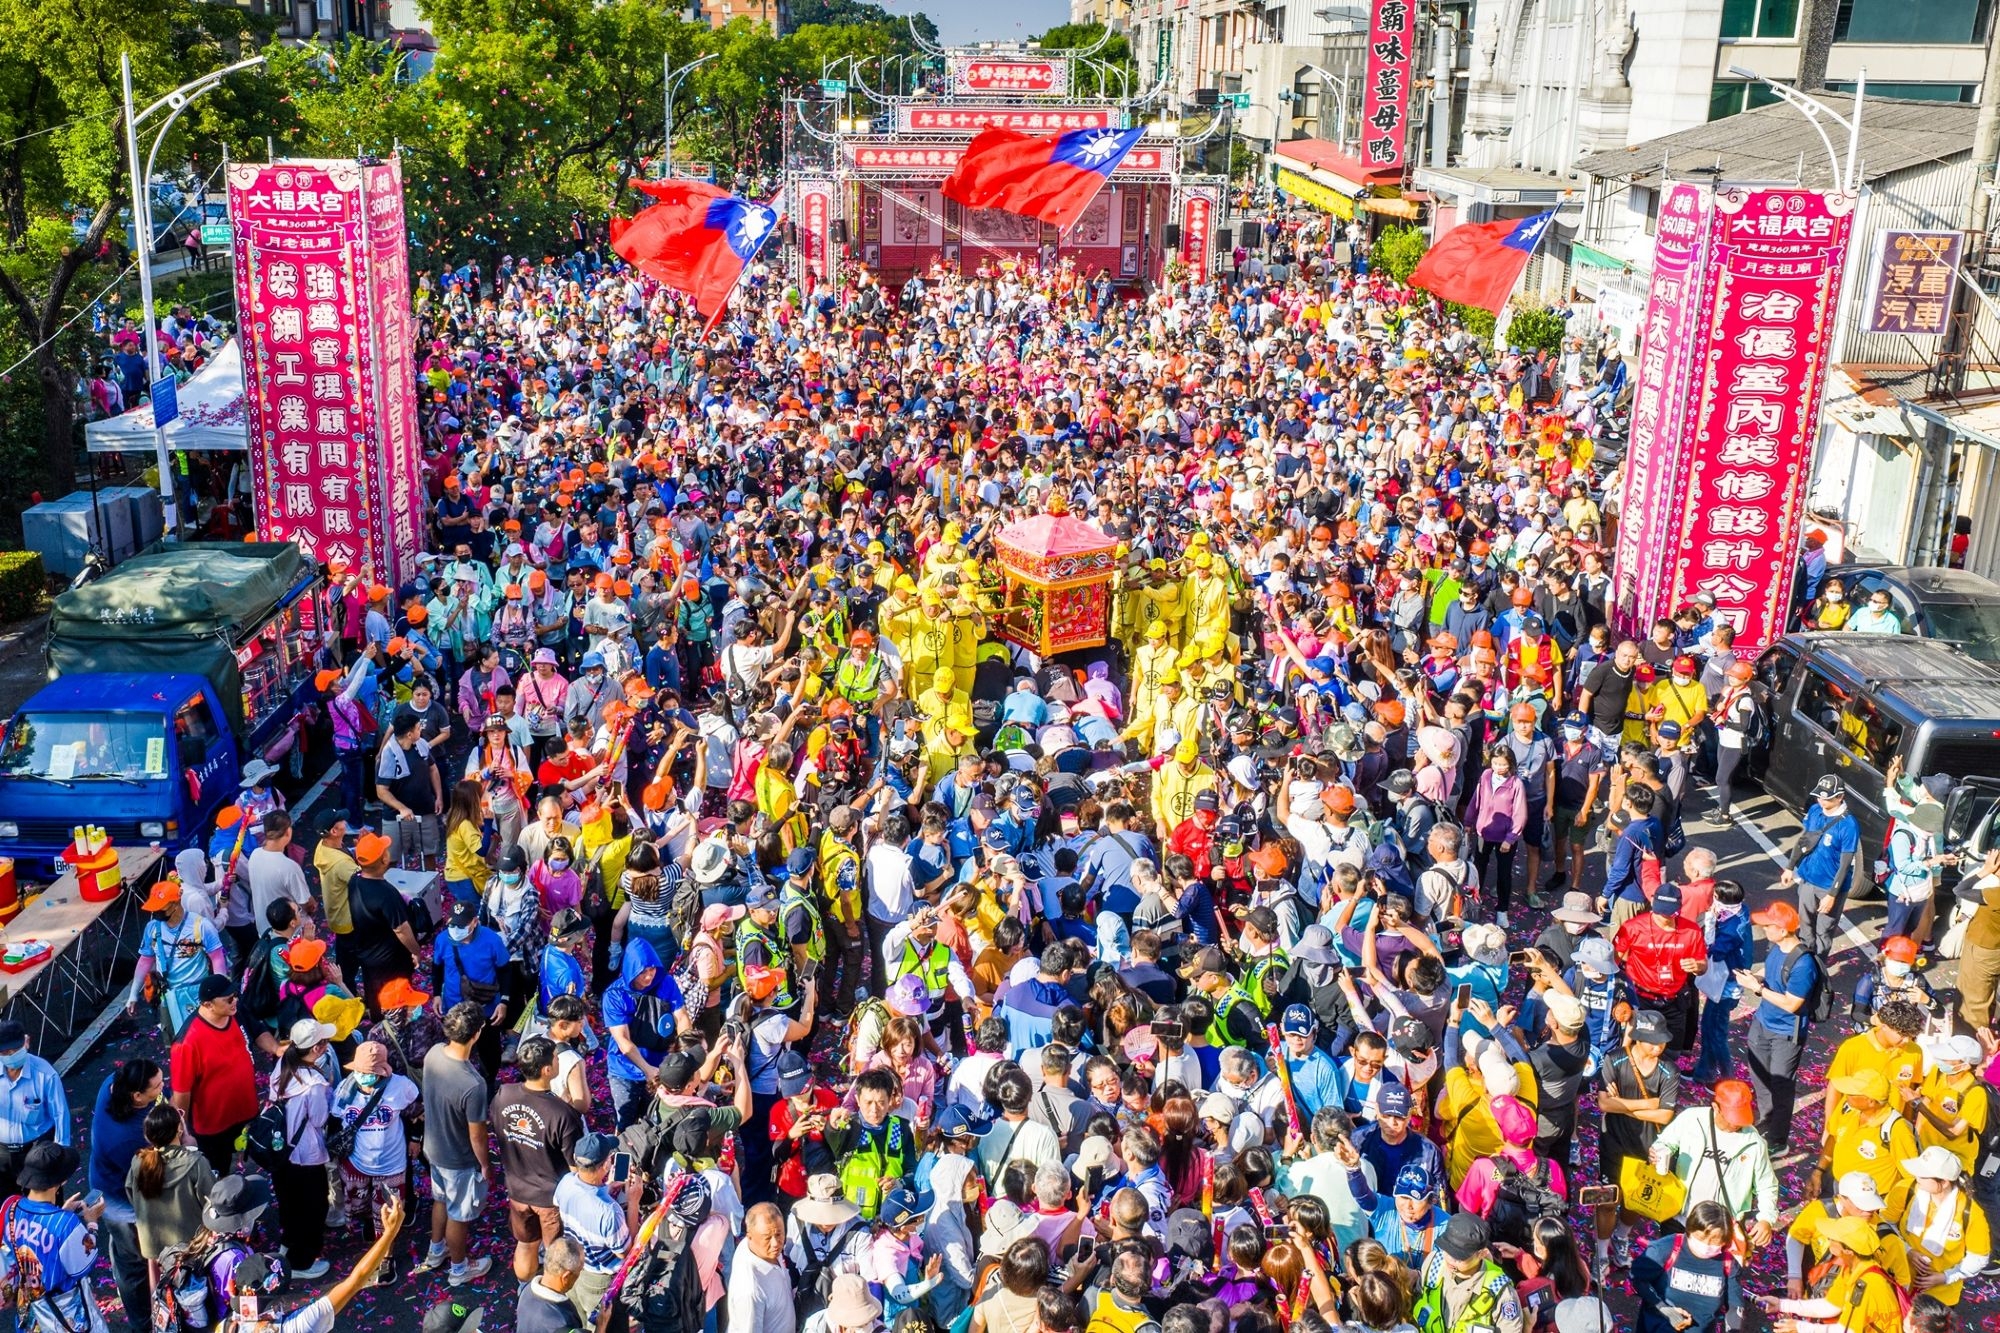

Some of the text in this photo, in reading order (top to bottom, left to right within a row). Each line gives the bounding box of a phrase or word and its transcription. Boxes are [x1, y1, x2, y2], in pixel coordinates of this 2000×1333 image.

[1368, 2, 1407, 164] 霸味薑母鴨
[248, 190, 343, 213] 大福興宮
[1731, 214, 1834, 238] 大福興宮
[265, 236, 332, 249] 月老祖廟
[1741, 261, 1813, 275] 月老祖廟
[1877, 300, 1944, 329] 汽車
[268, 261, 319, 557] 宏鋼工業有限公
[501, 1103, 521, 1118] POINT
